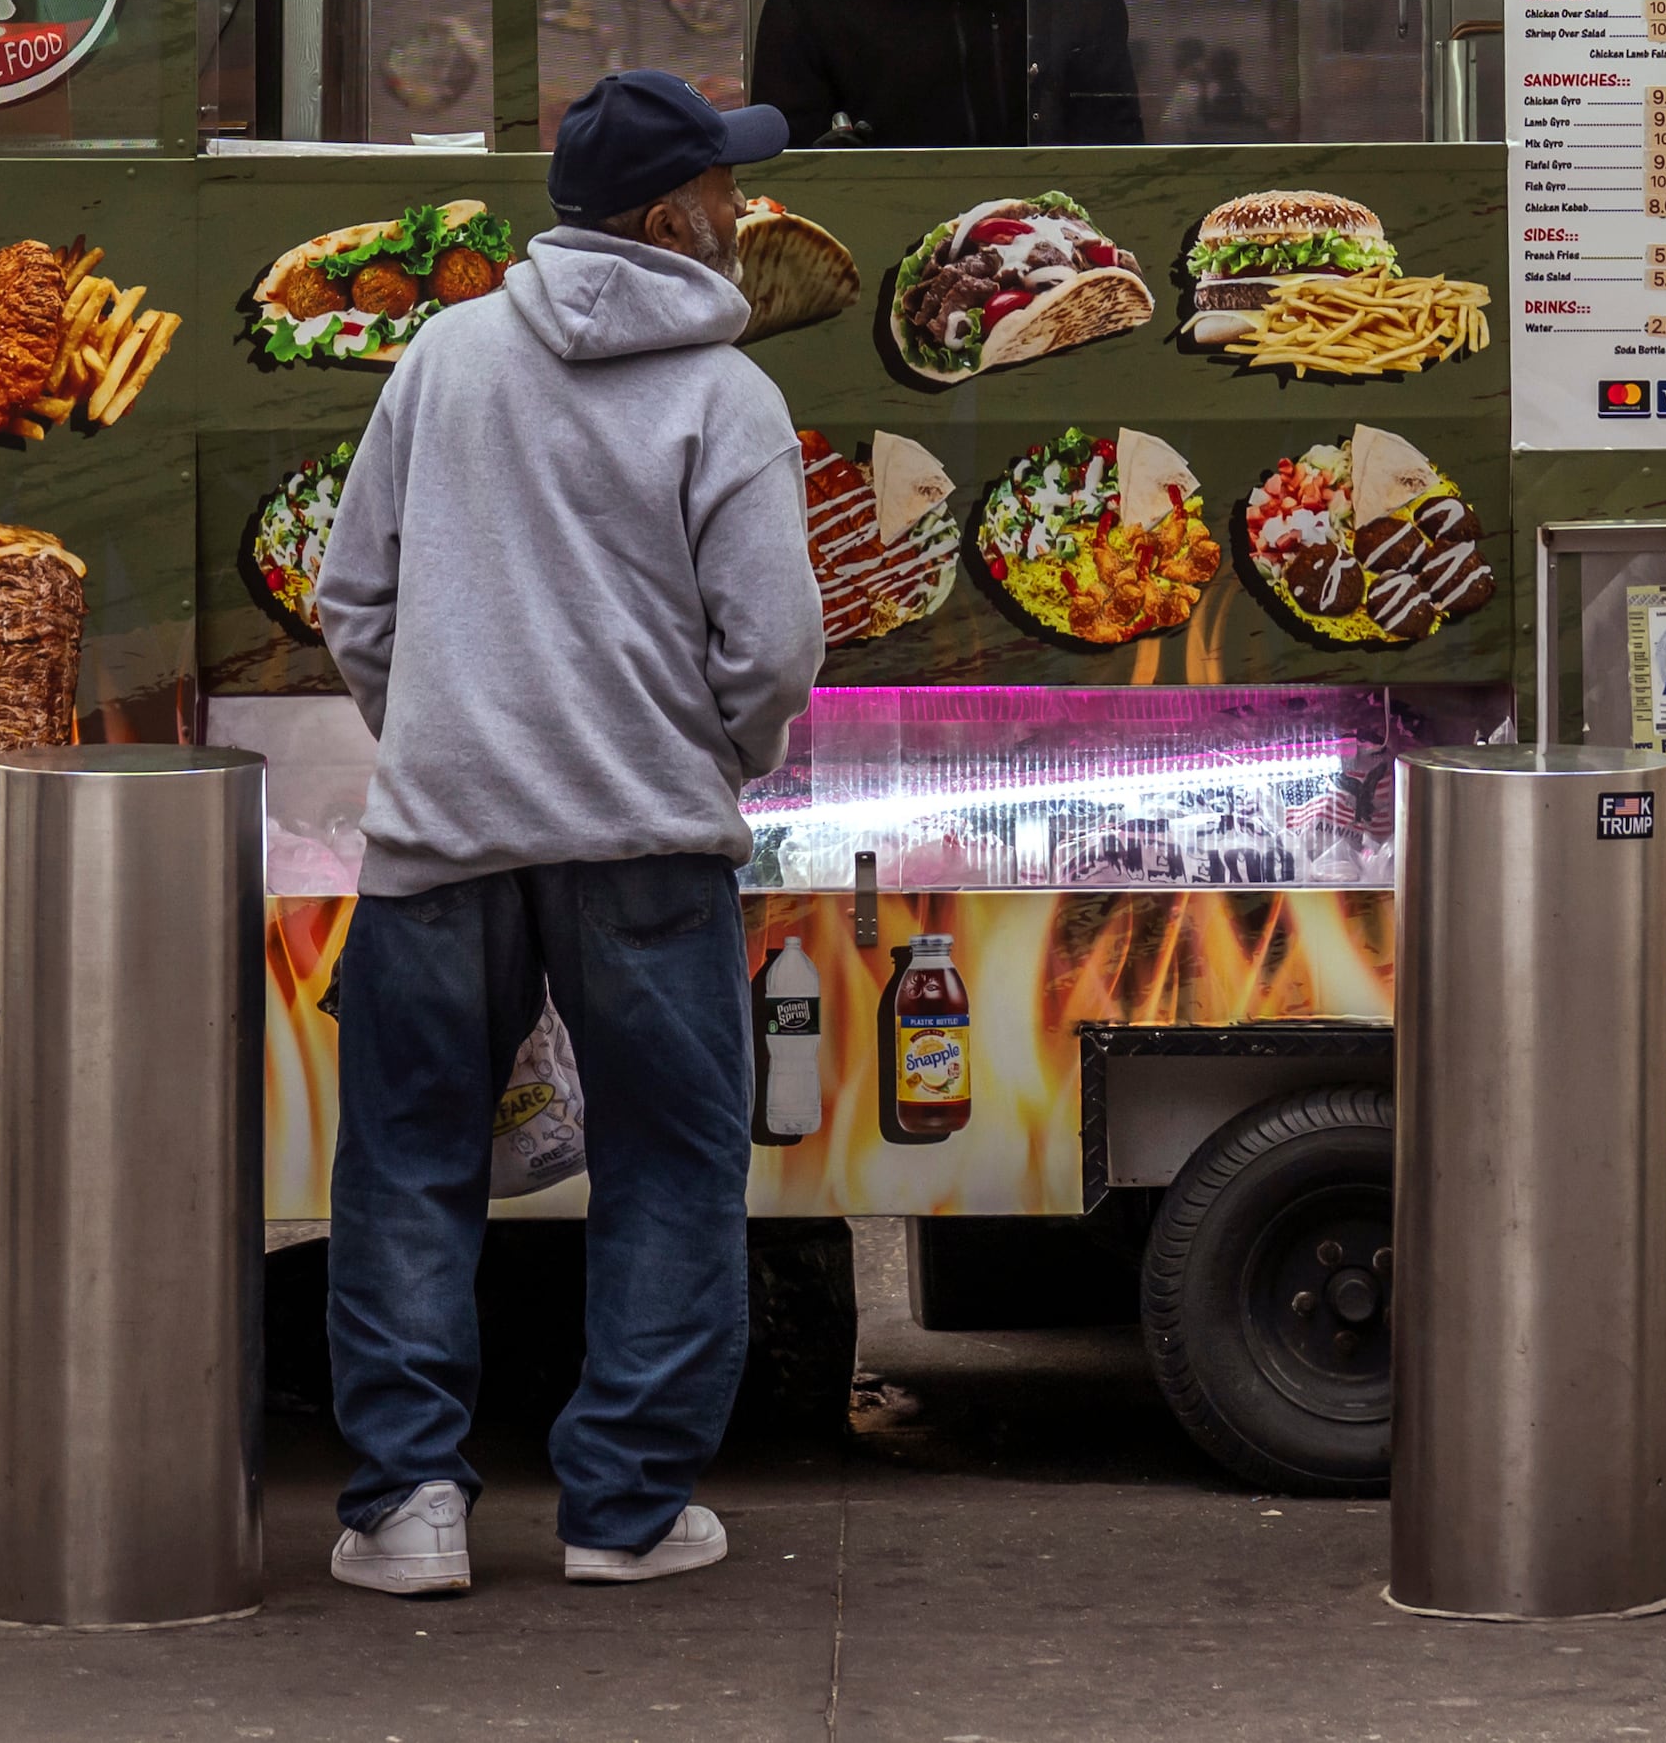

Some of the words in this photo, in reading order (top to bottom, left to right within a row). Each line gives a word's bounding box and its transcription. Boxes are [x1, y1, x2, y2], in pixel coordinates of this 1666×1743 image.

[5, 31, 63, 75] FOOD
[1614, 345, 1637, 355] Soda
[1638, 345, 1666, 355] Bottle
[1599, 816, 1653, 835] TRUMP
[776, 999, 810, 1017] Poland
[778, 1009, 811, 1027] Spring
[909, 1018, 934, 1026] PLASTIC
[905, 1043, 961, 1072] Snapple
